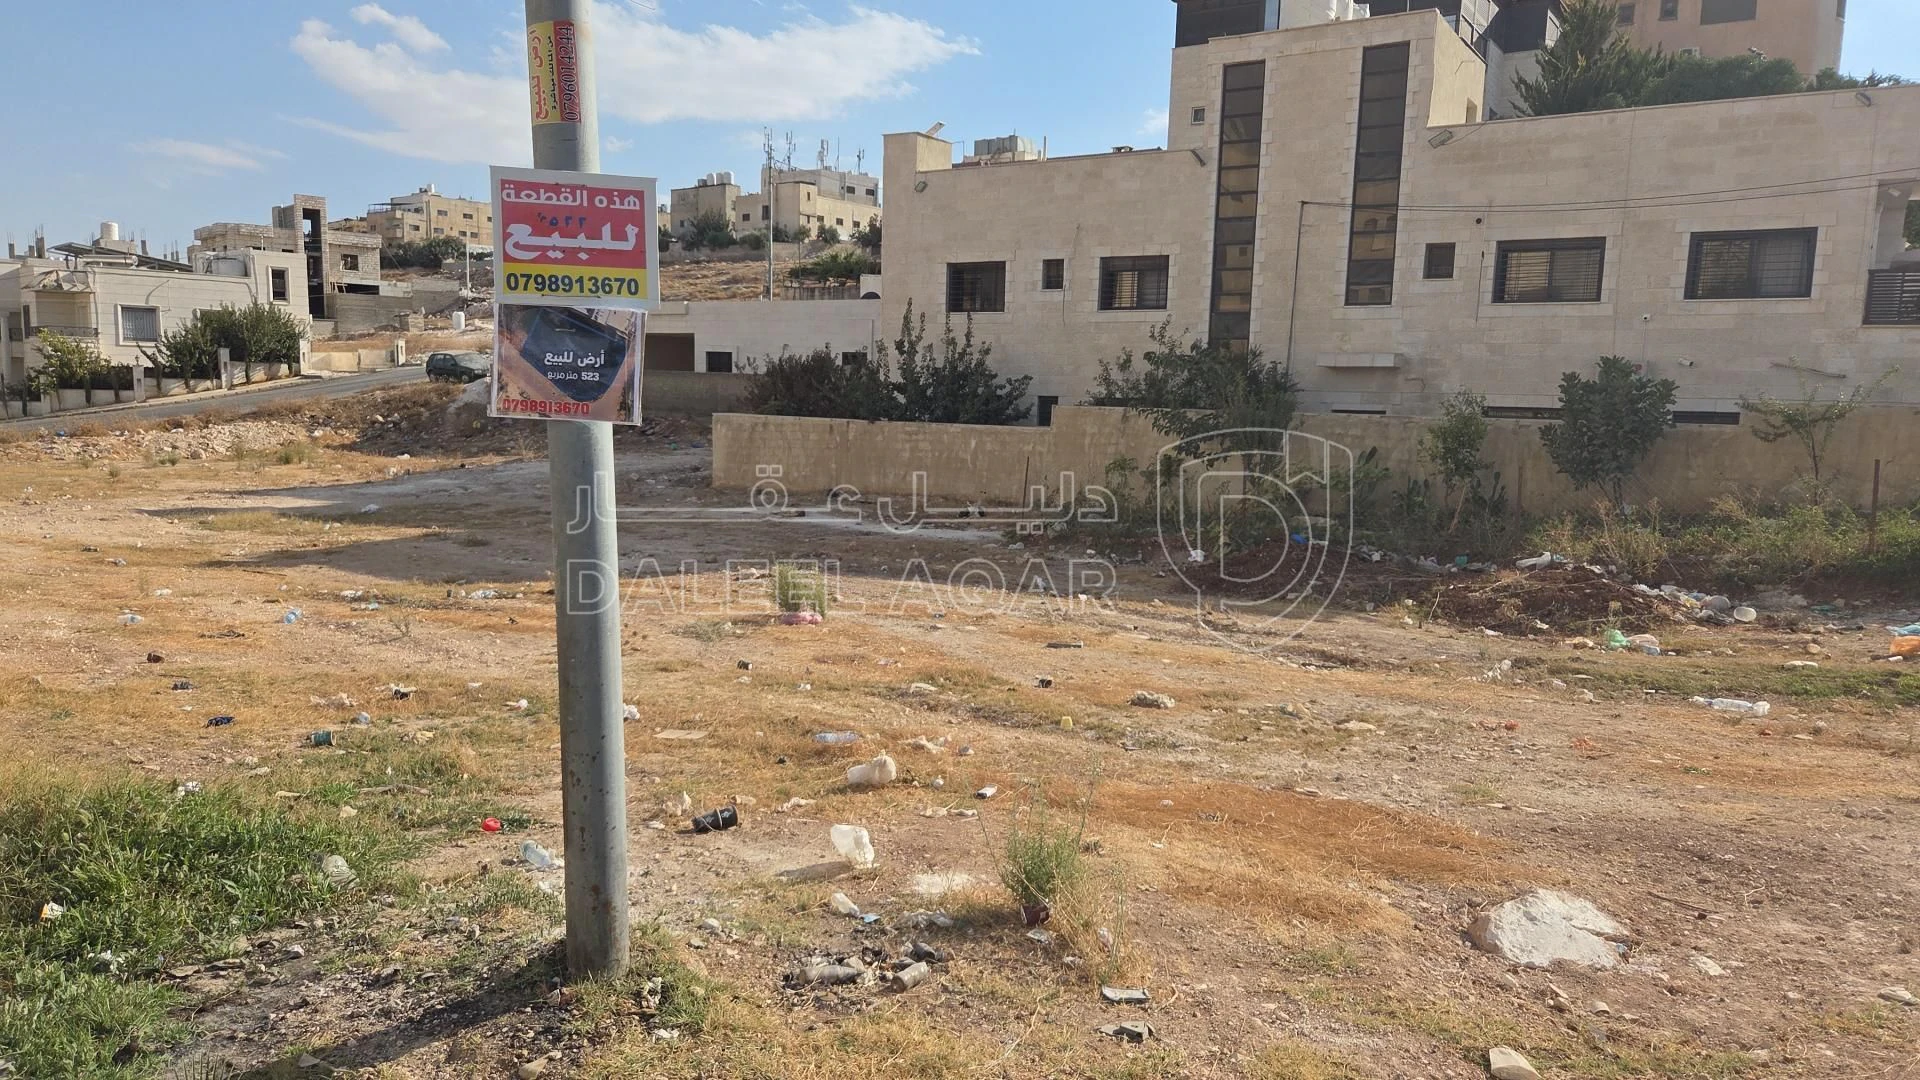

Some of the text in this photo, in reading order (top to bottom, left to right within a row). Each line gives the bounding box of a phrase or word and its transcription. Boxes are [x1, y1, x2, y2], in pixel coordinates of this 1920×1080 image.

[559, 25, 578, 121] 0796014244
[501, 184, 641, 210] هذه القطعة
[505, 222, 639, 260] للبيع
[506, 272, 640, 296] 0798913670
[544, 349, 605, 367] أرض للبيع
[581, 371, 600, 381] 523
[502, 399, 590, 416] 0798913670
